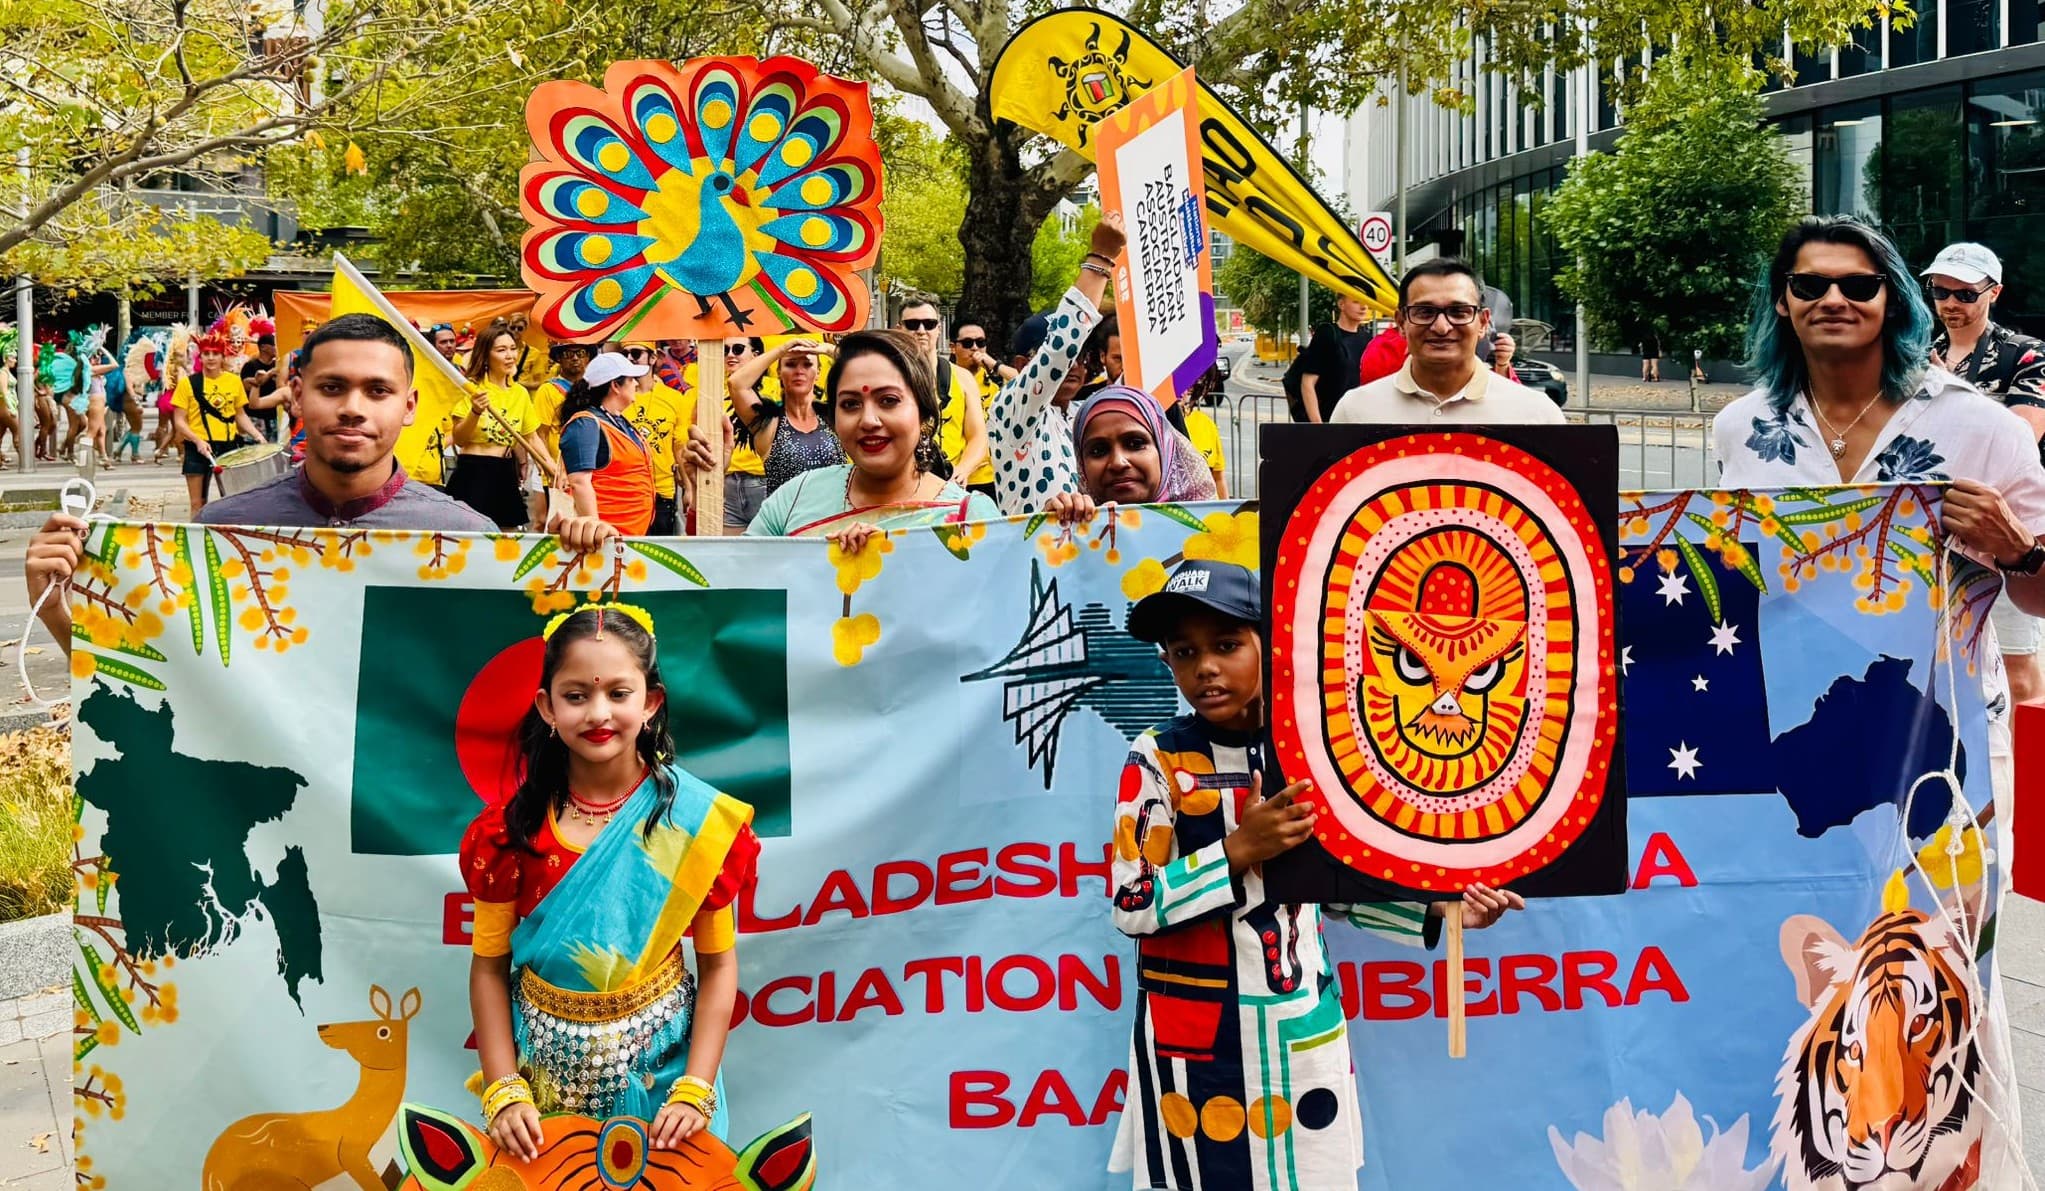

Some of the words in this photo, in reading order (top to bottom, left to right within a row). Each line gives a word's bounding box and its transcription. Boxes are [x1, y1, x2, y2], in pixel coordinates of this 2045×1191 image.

[1136, 201, 1157, 333] CANBERRA
[1144, 183, 1168, 335] ASSOCIATION
[1154, 180, 1176, 323] AUSTRALIAN
[1163, 163, 1186, 321] BANGLADESH
[1366, 227, 1386, 242] 40
[141, 311, 180, 319] MEMBER
[1337, 946, 1690, 1021] BERRA
